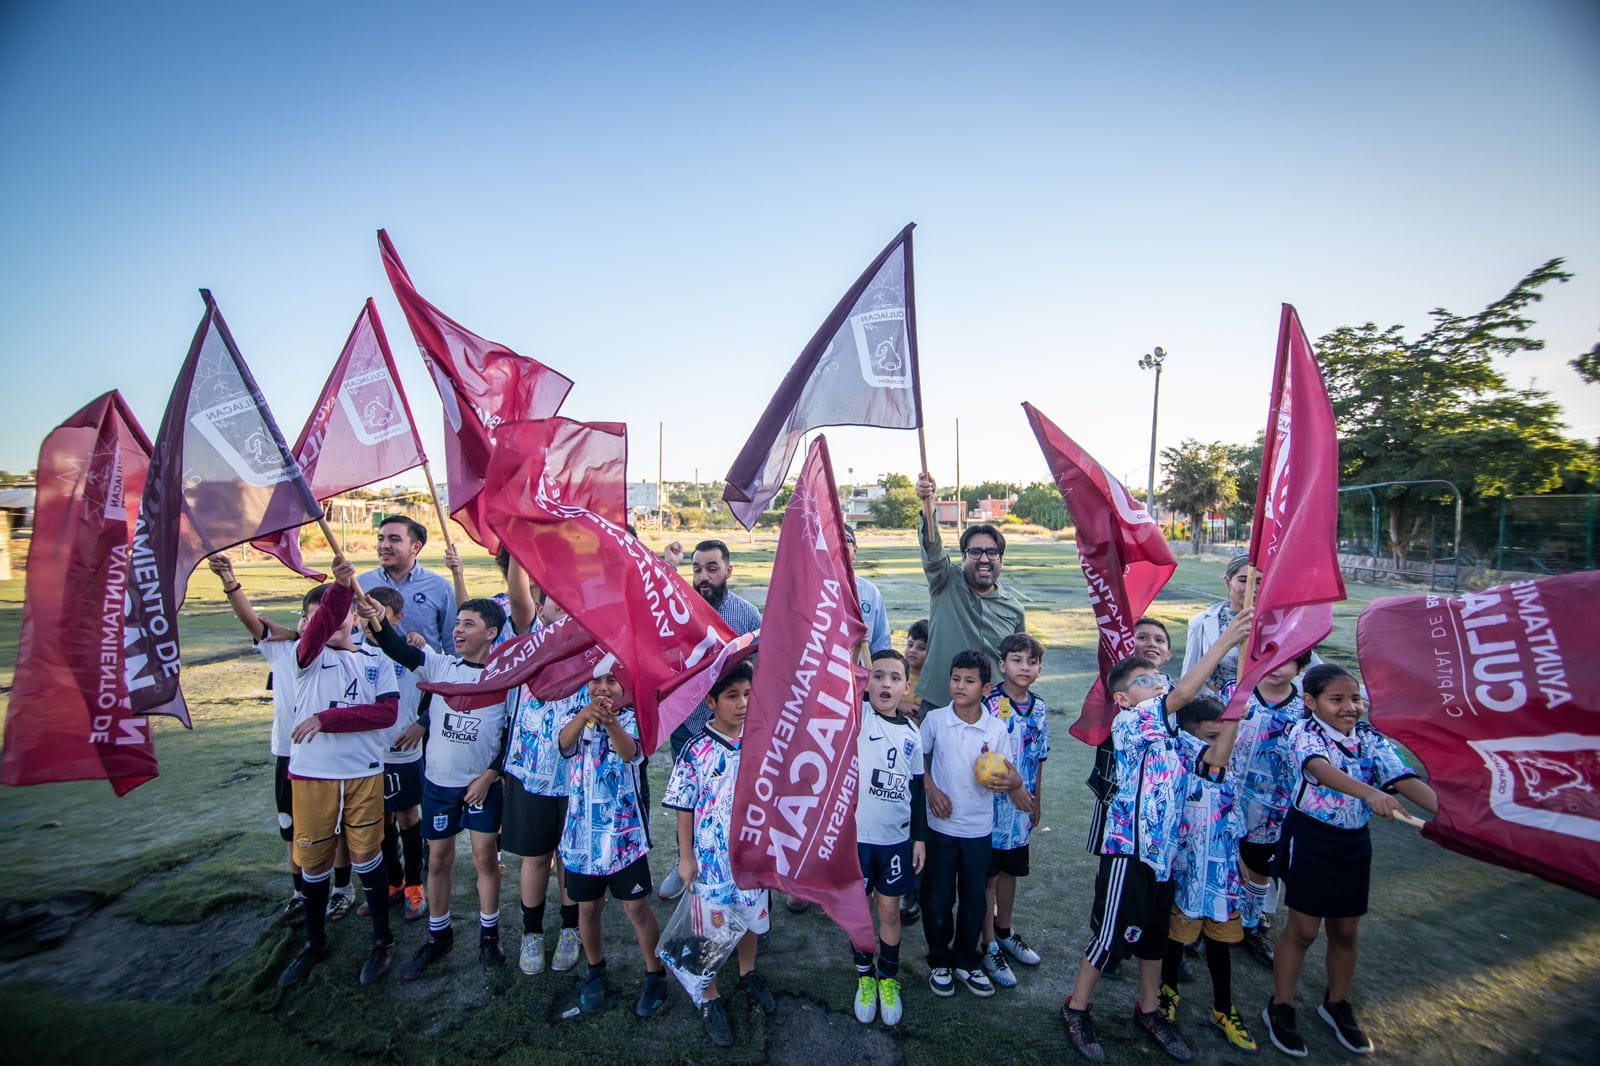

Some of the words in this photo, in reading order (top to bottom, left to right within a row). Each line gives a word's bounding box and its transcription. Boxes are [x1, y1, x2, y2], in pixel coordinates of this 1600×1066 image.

[155, 640, 181, 678] DE
[441, 730, 478, 742] NOTICIAS
[887, 747, 897, 769] 9
[890, 854, 903, 877] 9
